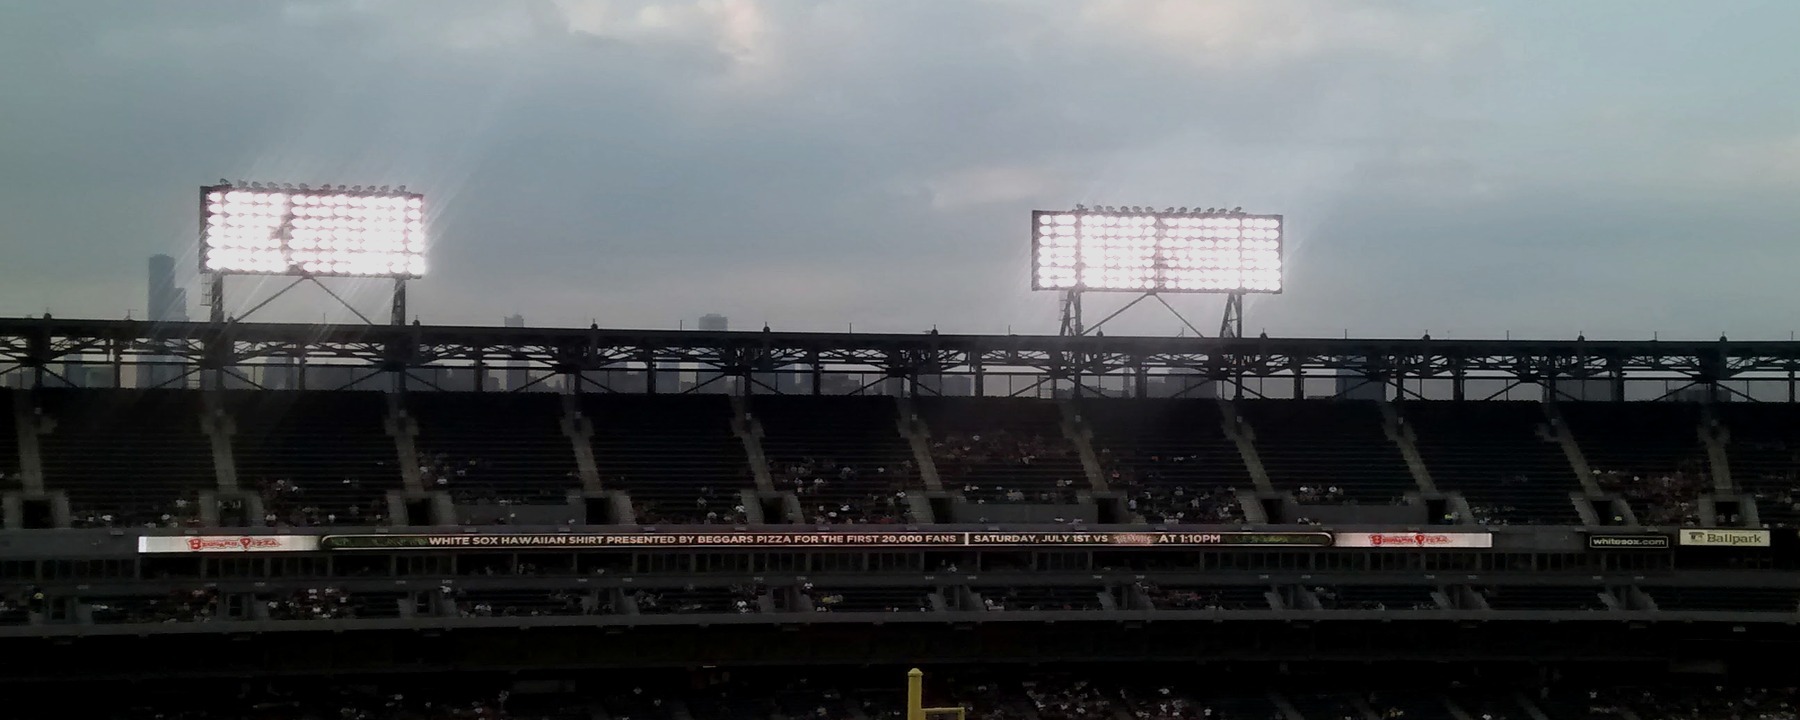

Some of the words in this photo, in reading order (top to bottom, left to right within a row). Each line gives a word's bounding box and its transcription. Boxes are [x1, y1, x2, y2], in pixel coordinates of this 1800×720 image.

[429, 536, 470, 545] WHITE
[472, 536, 499, 545] SOX
[501, 536, 567, 545] HAWAIIAN
[568, 536, 604, 544] SHIRT
[606, 536, 677, 544] PRESENTED
[679, 536, 695, 544] BY
[697, 535, 754, 544] BEGGARS
[756, 535, 792, 544] PIZZA
[794, 535, 819, 544] FOR
[821, 535, 844, 543] THE
[846, 535, 880, 543] FIRST
[881, 535, 923, 544] 20,000
[925, 535, 957, 543] FANS
[974, 534, 1040, 544] SATURDAY,
[1041, 534, 1069, 543] JULY
[1072, 534, 1091, 543] 1ST
[1093, 534, 1109, 543] VS
[1158, 534, 1177, 543] AT
[1180, 534, 1221, 543] 1:10PM
[1592, 537, 1666, 545] whitesox.com
[1706, 533, 1762, 545] Ballpark
